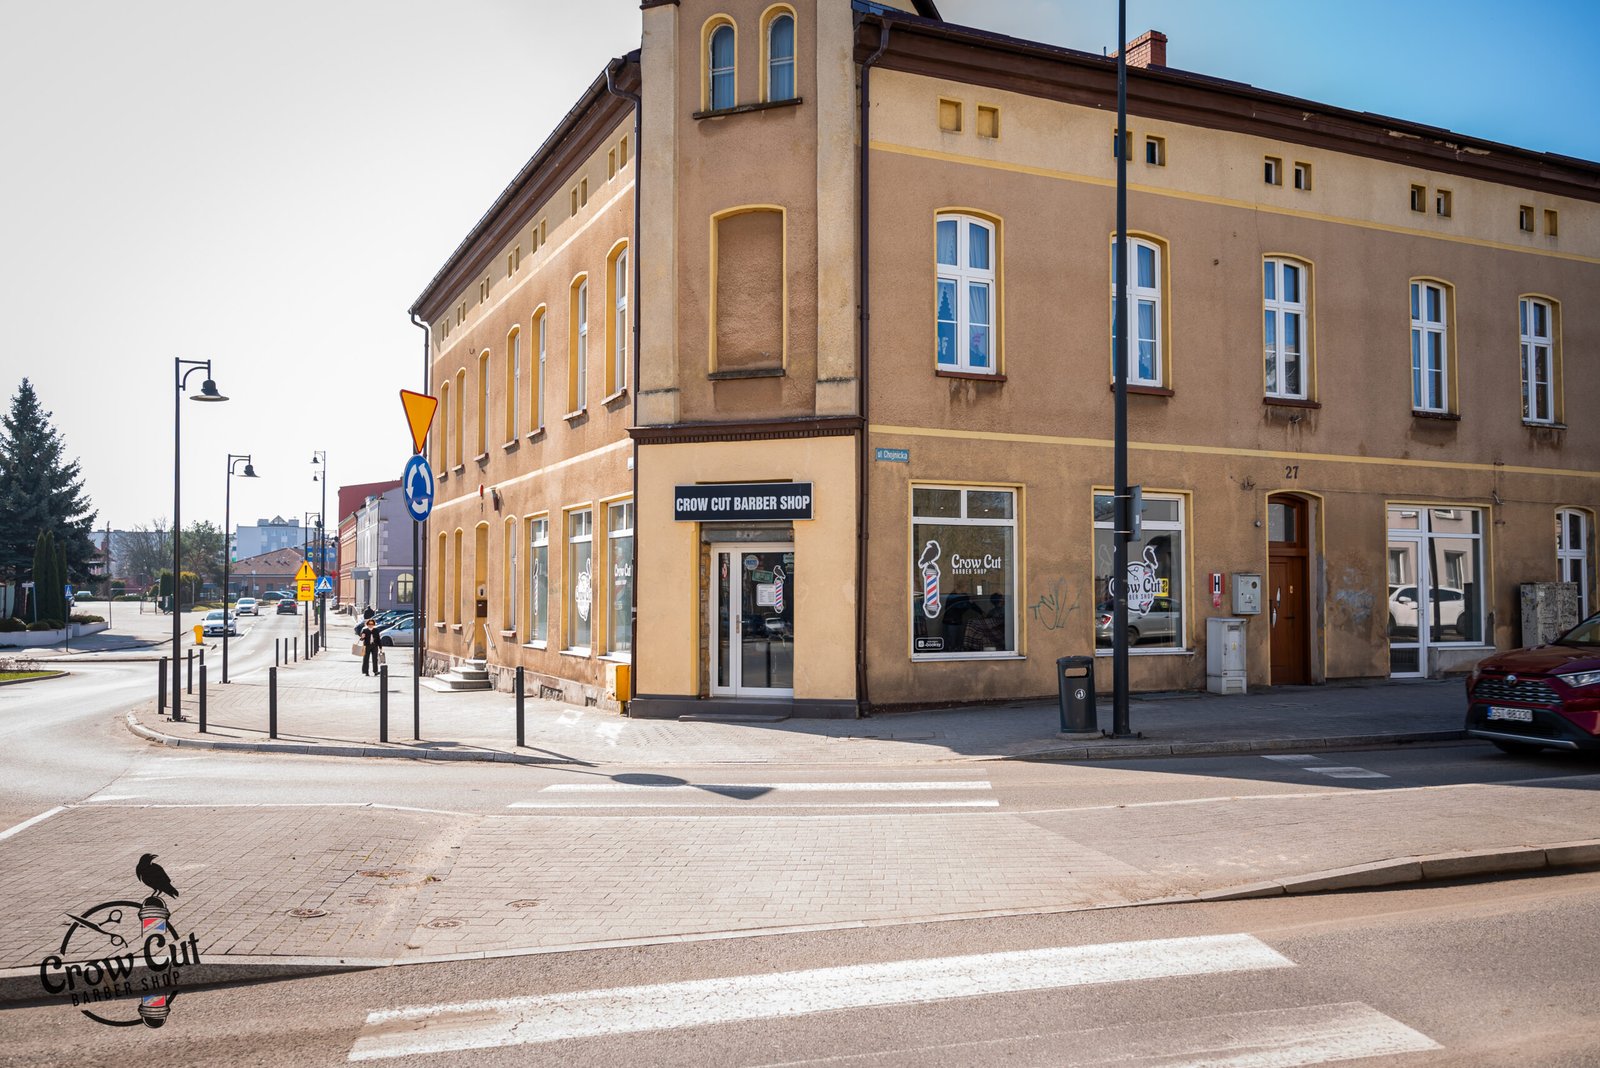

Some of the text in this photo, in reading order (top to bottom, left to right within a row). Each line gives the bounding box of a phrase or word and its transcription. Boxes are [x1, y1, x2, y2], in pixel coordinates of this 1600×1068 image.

[1285, 465, 1299, 479] 27
[676, 495, 810, 512] CROW CUT BARBER SHOP
[951, 553, 1002, 569] Crow Cut
[1143, 578, 1161, 594] Cut
[1214, 575, 1220, 592] H
